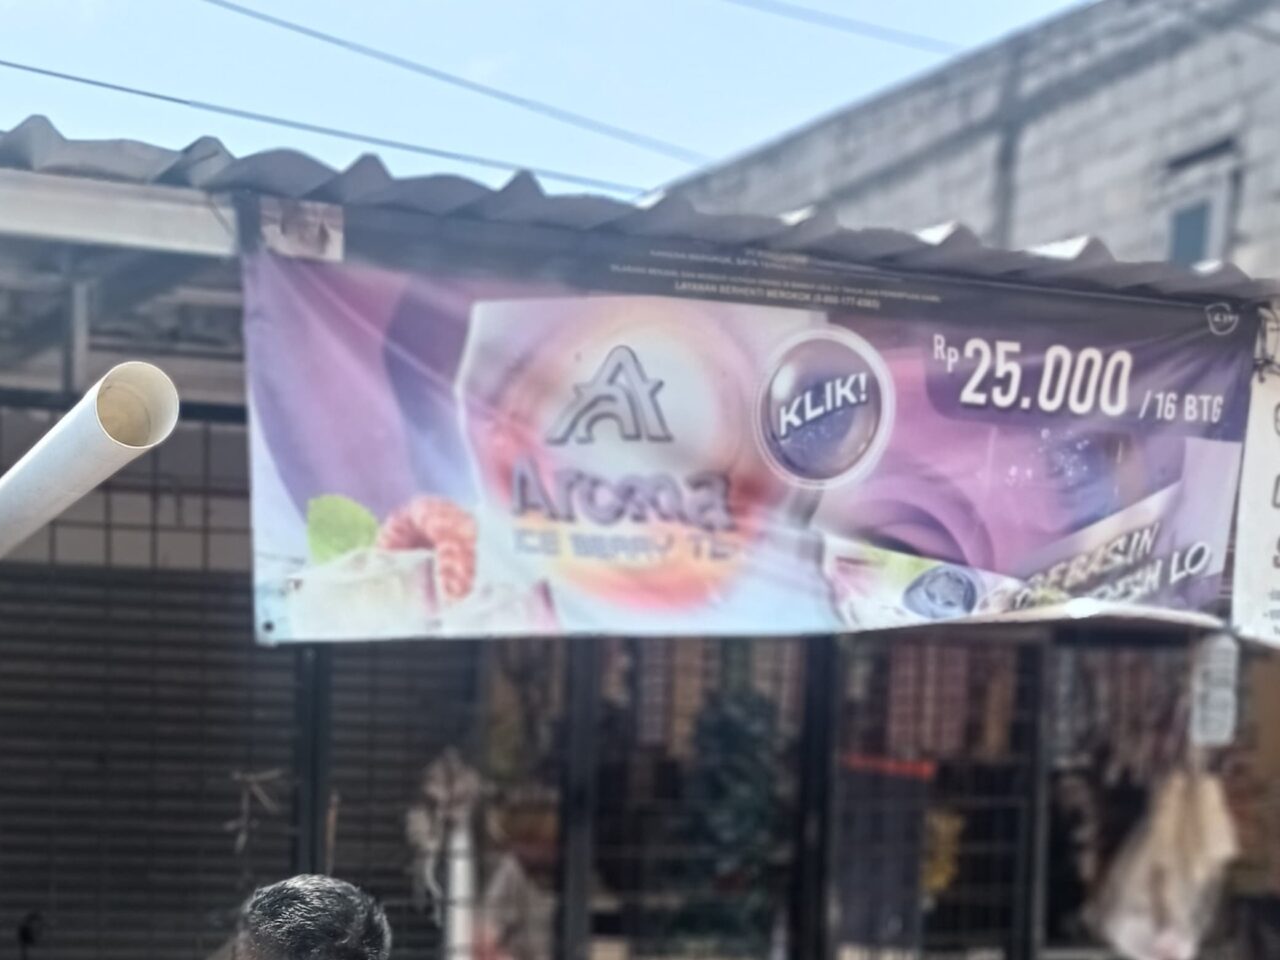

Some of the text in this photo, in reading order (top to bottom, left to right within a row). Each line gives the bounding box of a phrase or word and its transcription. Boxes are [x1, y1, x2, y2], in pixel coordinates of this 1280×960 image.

[779, 371, 867, 437] KLIK!
[933, 334, 959, 373] Rp
[960, 338, 1133, 416] 25.000
[1184, 394, 1224, 423] BTG
[1169, 540, 1211, 584] LO
